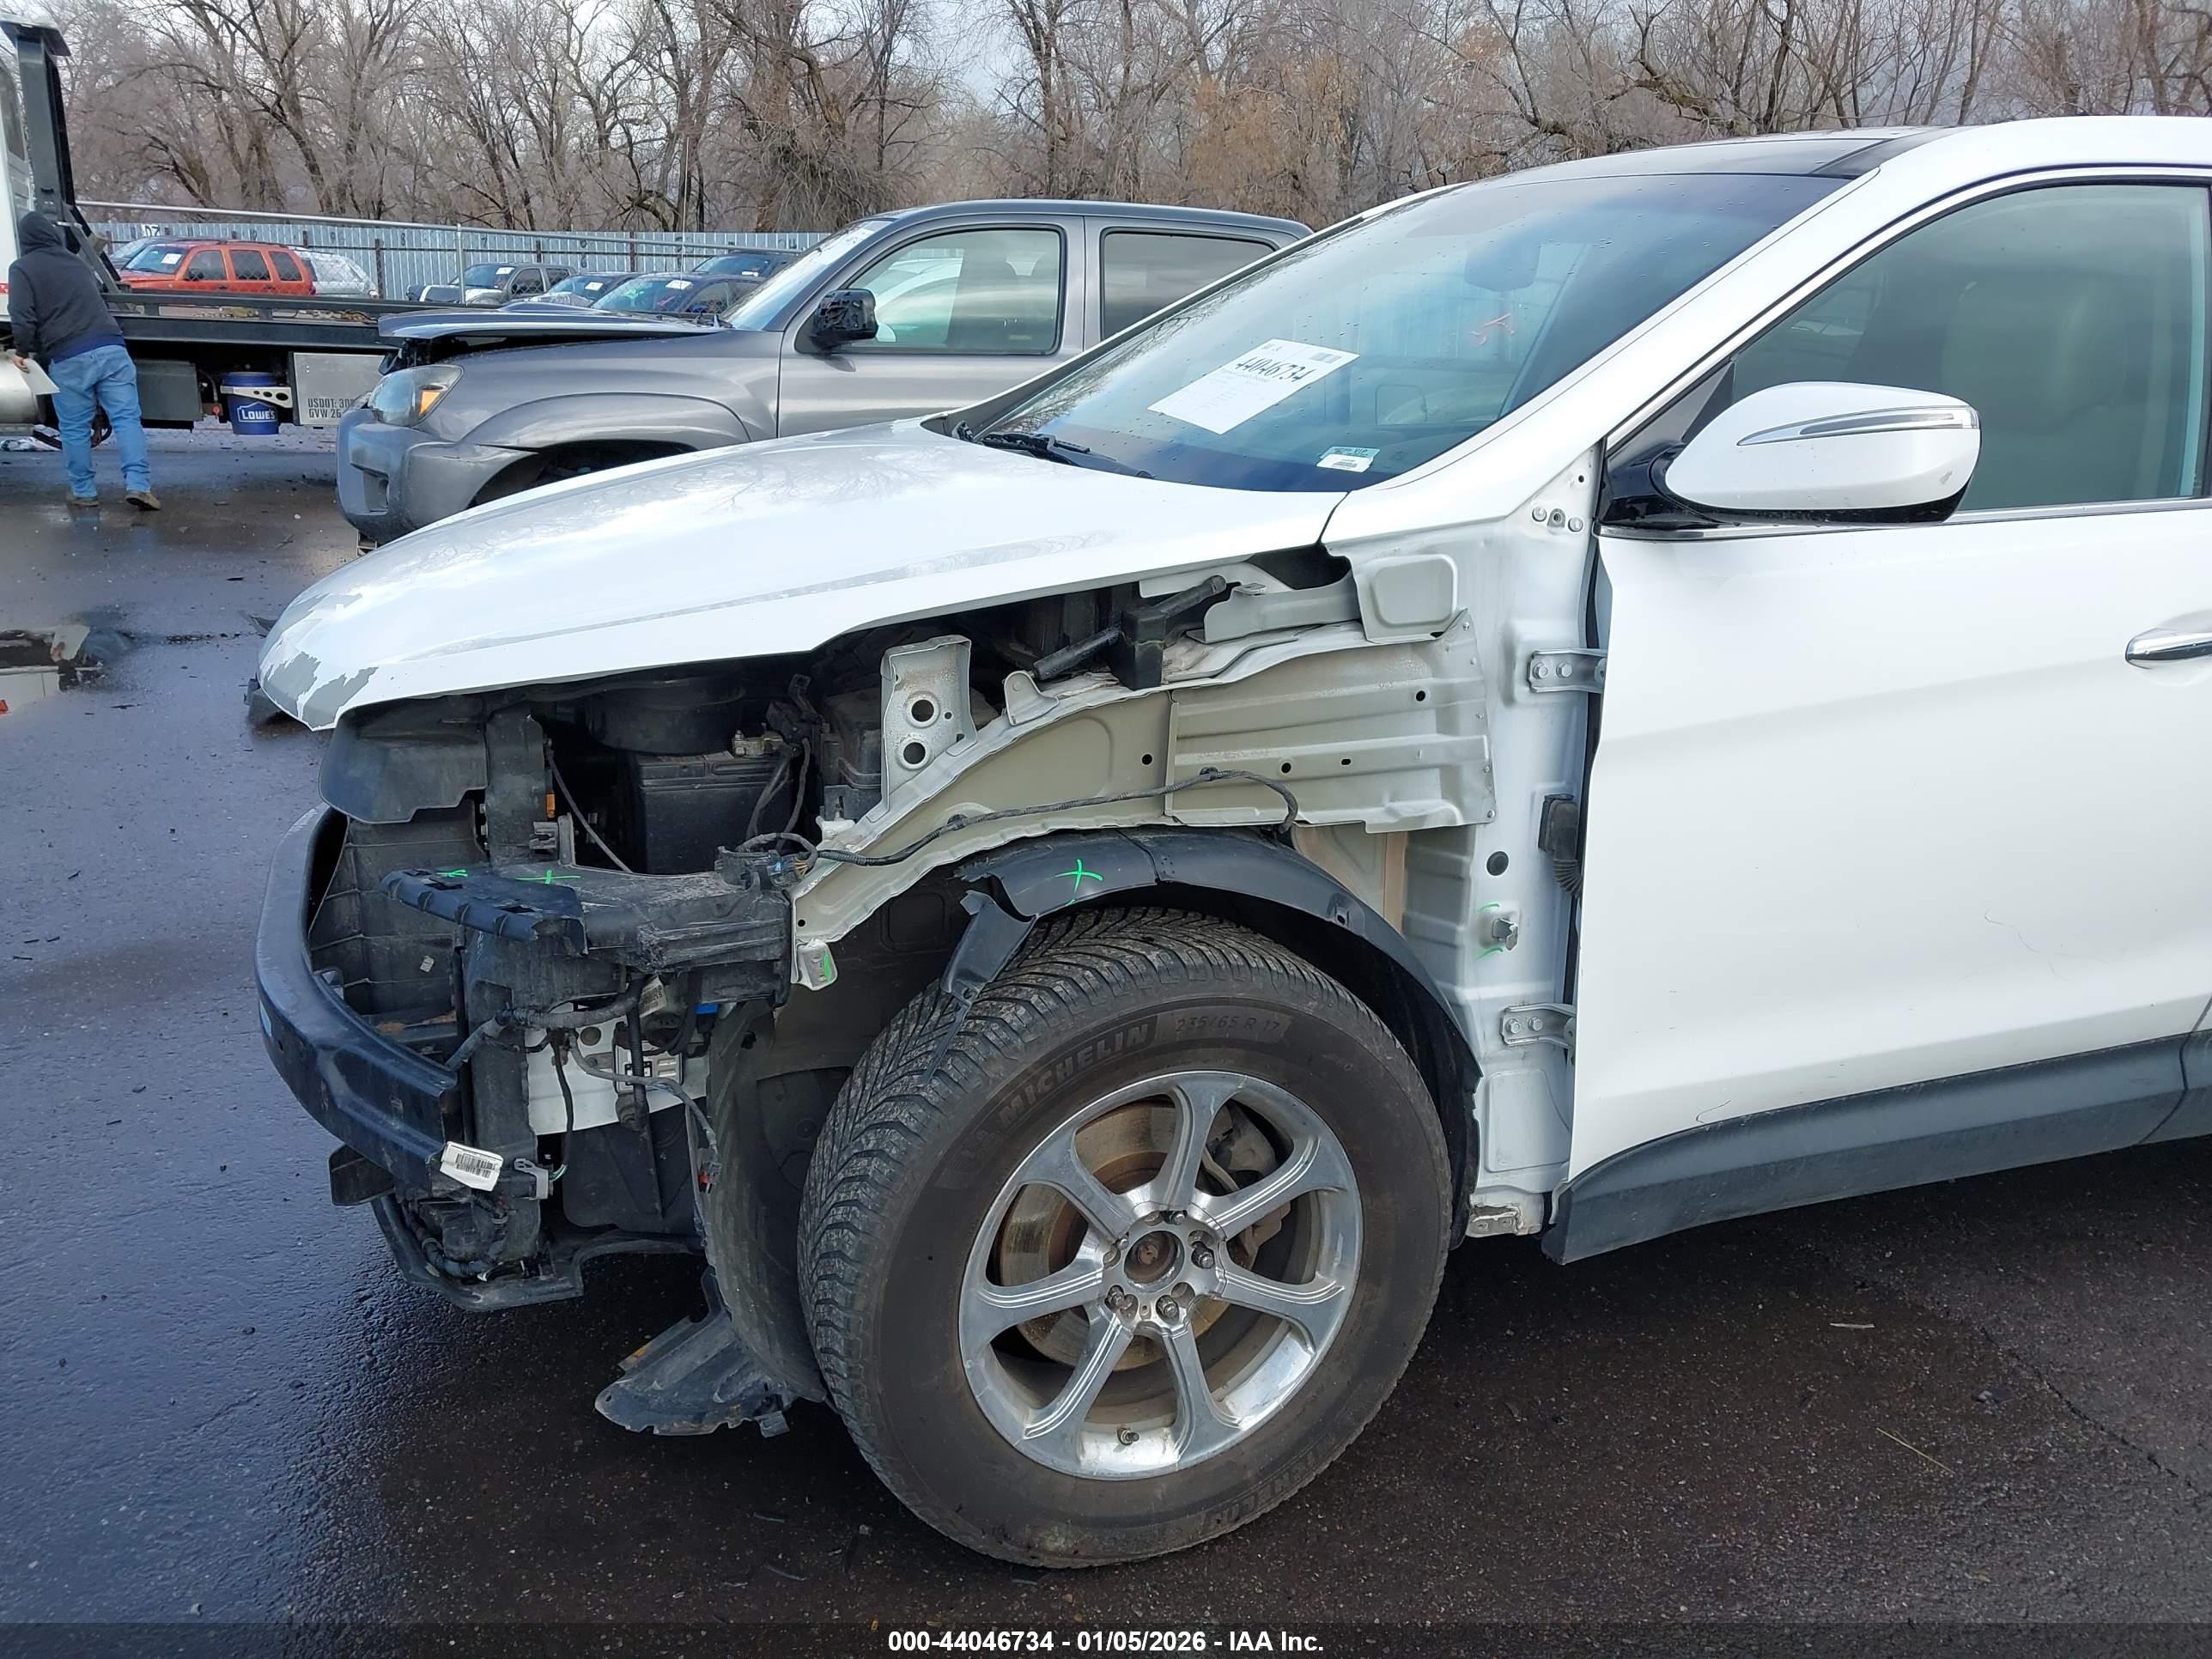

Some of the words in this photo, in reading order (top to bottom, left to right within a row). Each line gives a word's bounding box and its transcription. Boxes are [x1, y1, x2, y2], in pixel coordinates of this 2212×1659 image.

[1235, 356, 1317, 383] 44046734
[308, 408, 328, 418] GVW
[1244, 1017, 1257, 1030] R
[998, 1023, 1151, 1126] MICHELIN
